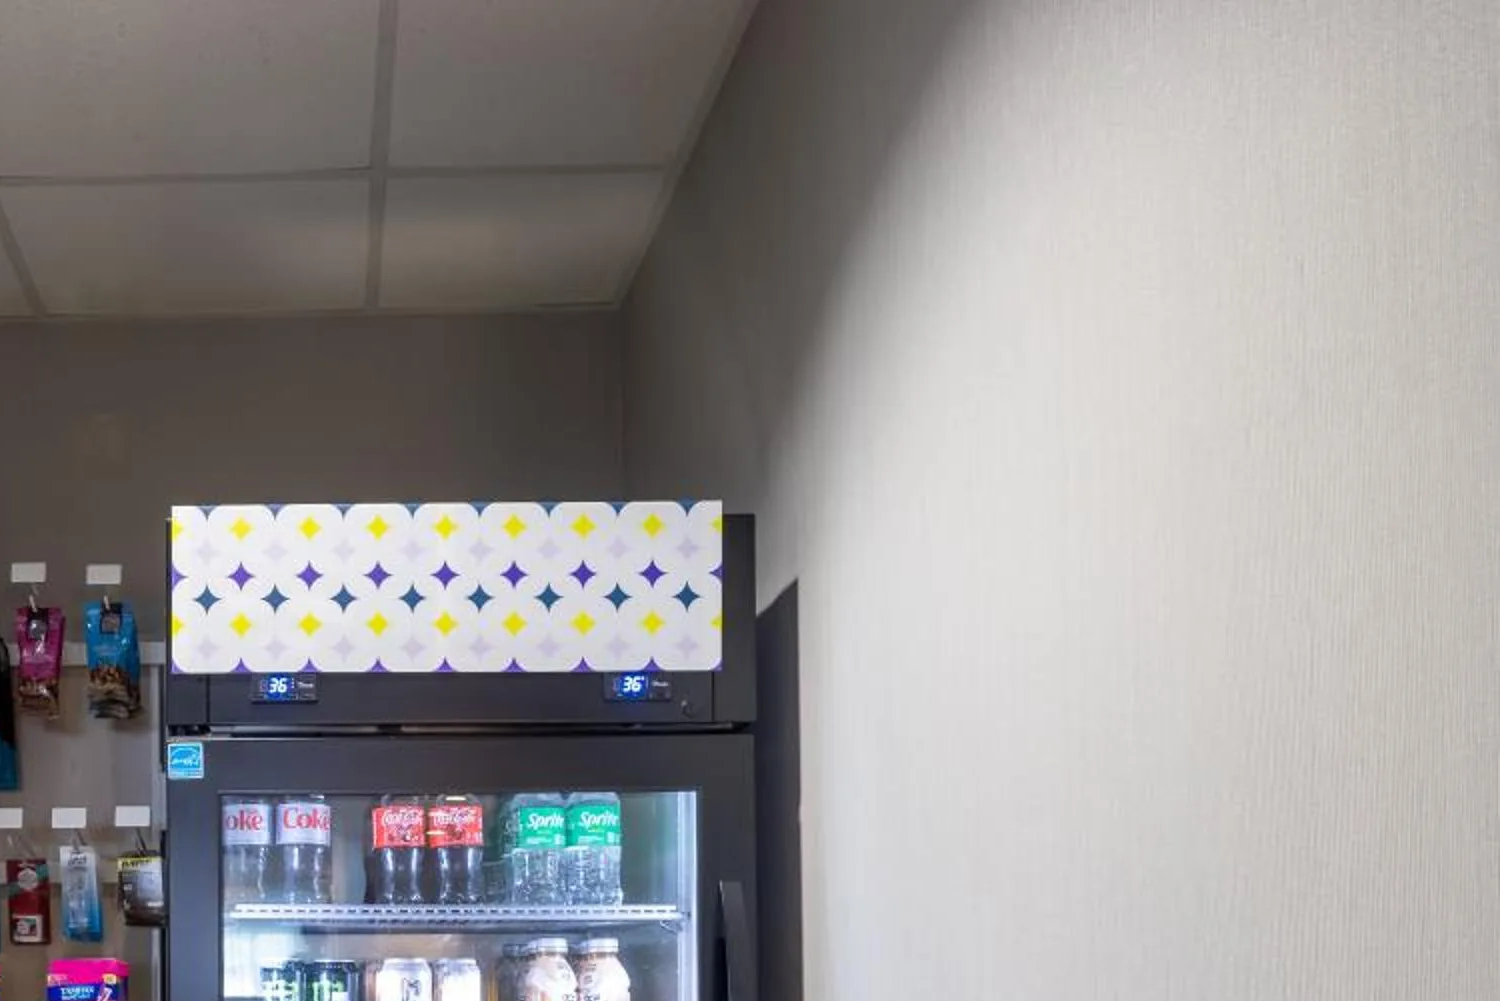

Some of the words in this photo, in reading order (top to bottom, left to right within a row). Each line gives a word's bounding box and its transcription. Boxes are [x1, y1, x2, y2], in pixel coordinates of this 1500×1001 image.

[268, 677, 288, 694] 36
[225, 807, 264, 831] oke
[282, 805, 331, 832] Coke
